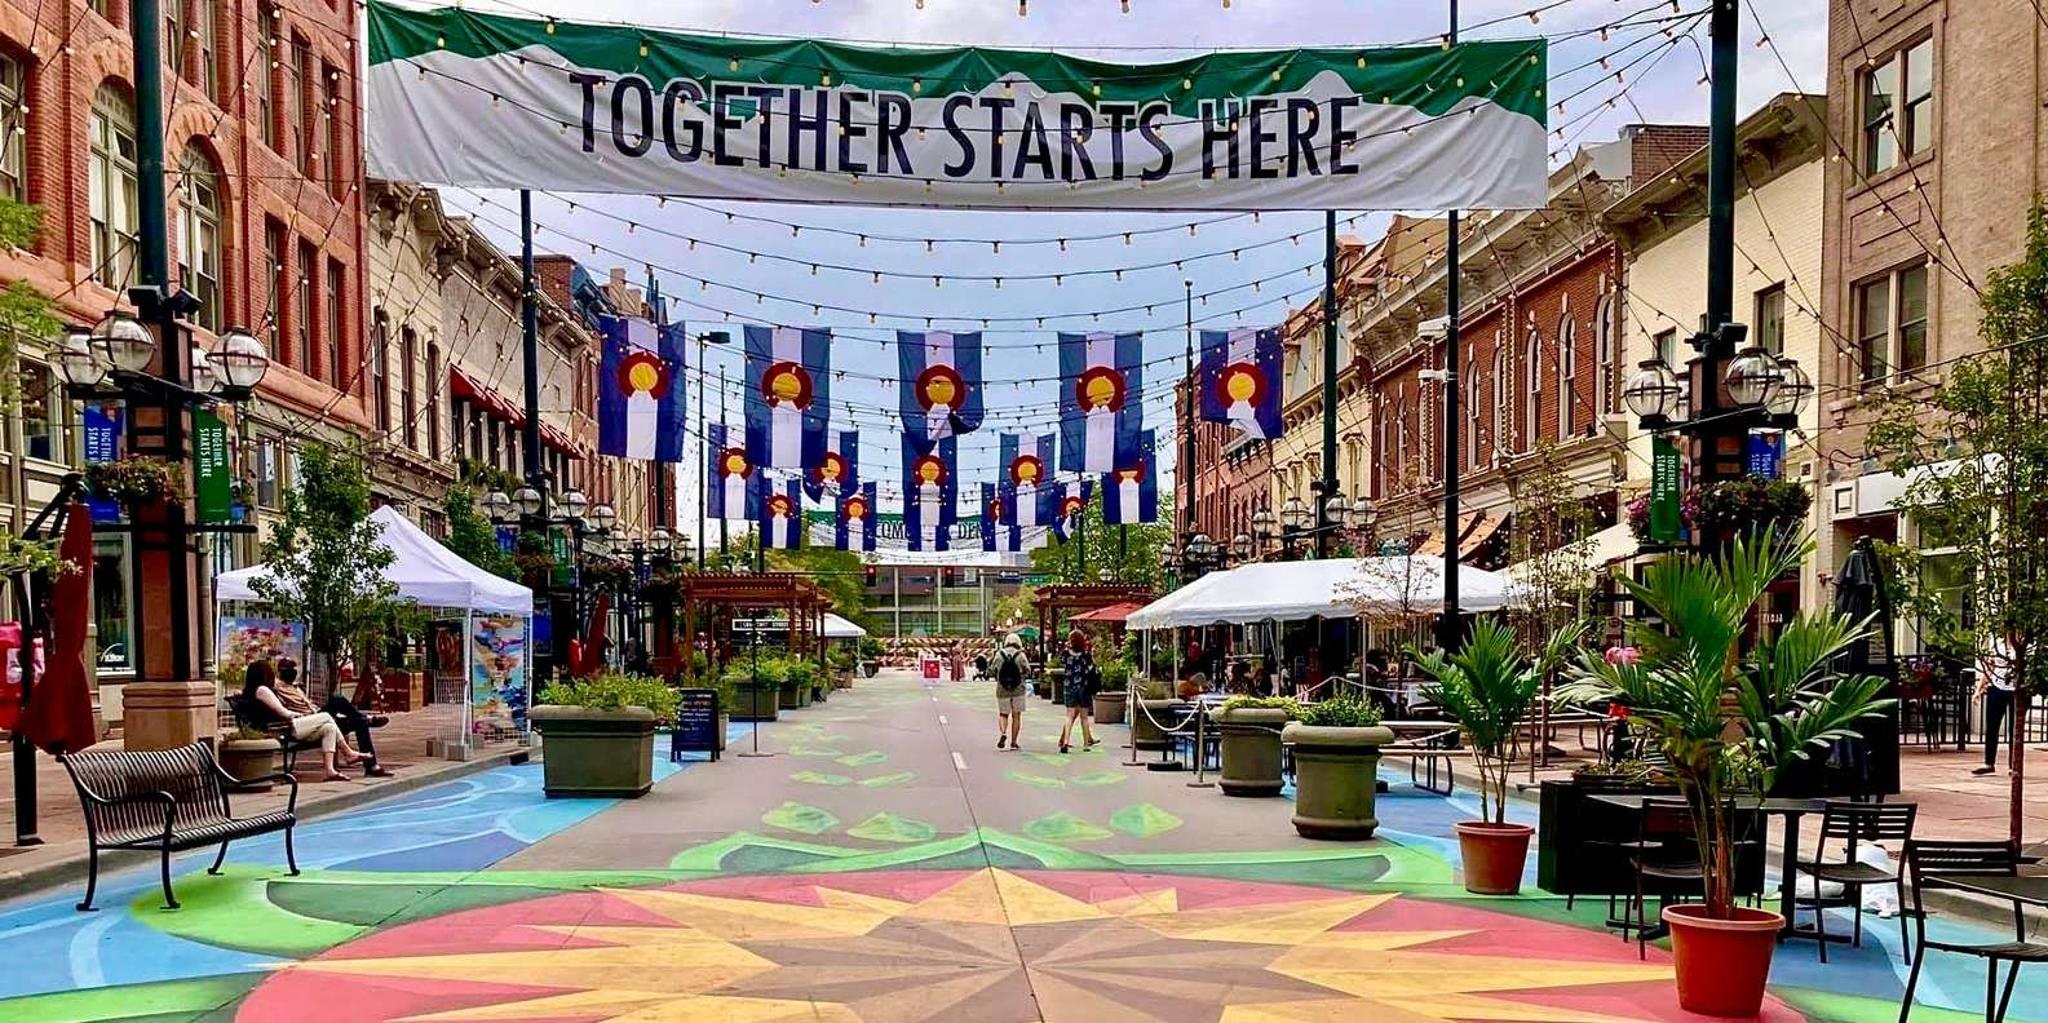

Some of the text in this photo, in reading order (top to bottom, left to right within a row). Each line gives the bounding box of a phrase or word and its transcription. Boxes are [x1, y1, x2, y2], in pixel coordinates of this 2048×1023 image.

[570, 73, 1360, 181] TOGETHER STARTS HERE
[101, 427, 112, 462] TOGETHE
[200, 427, 212, 478] STARTS HERE
[212, 428, 223, 467] TOGETHER
[1667, 455, 1676, 491] TOGETHER
